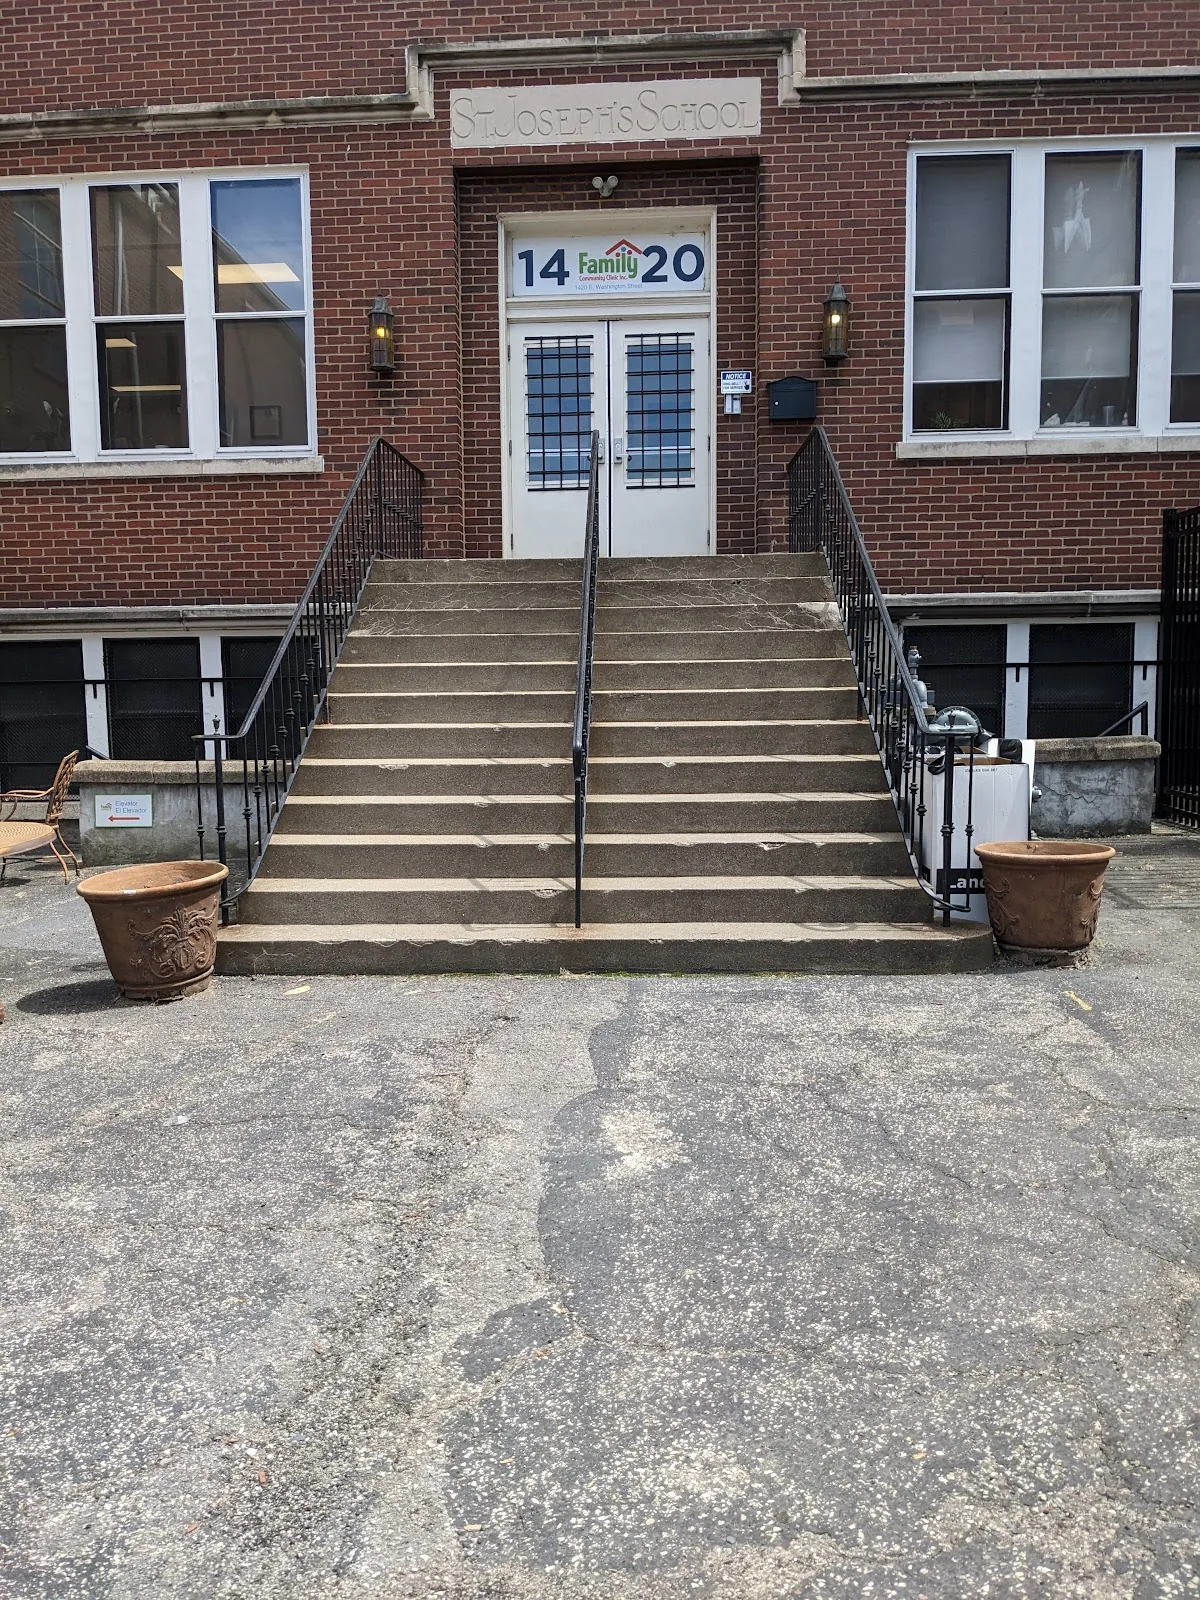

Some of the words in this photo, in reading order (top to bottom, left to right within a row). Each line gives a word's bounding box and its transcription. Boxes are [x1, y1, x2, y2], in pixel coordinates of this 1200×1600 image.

[636, 89, 759, 132] SCHOOL
[517, 248, 570, 287] 14
[641, 243, 705, 283] 20
[578, 250, 638, 278] Family
